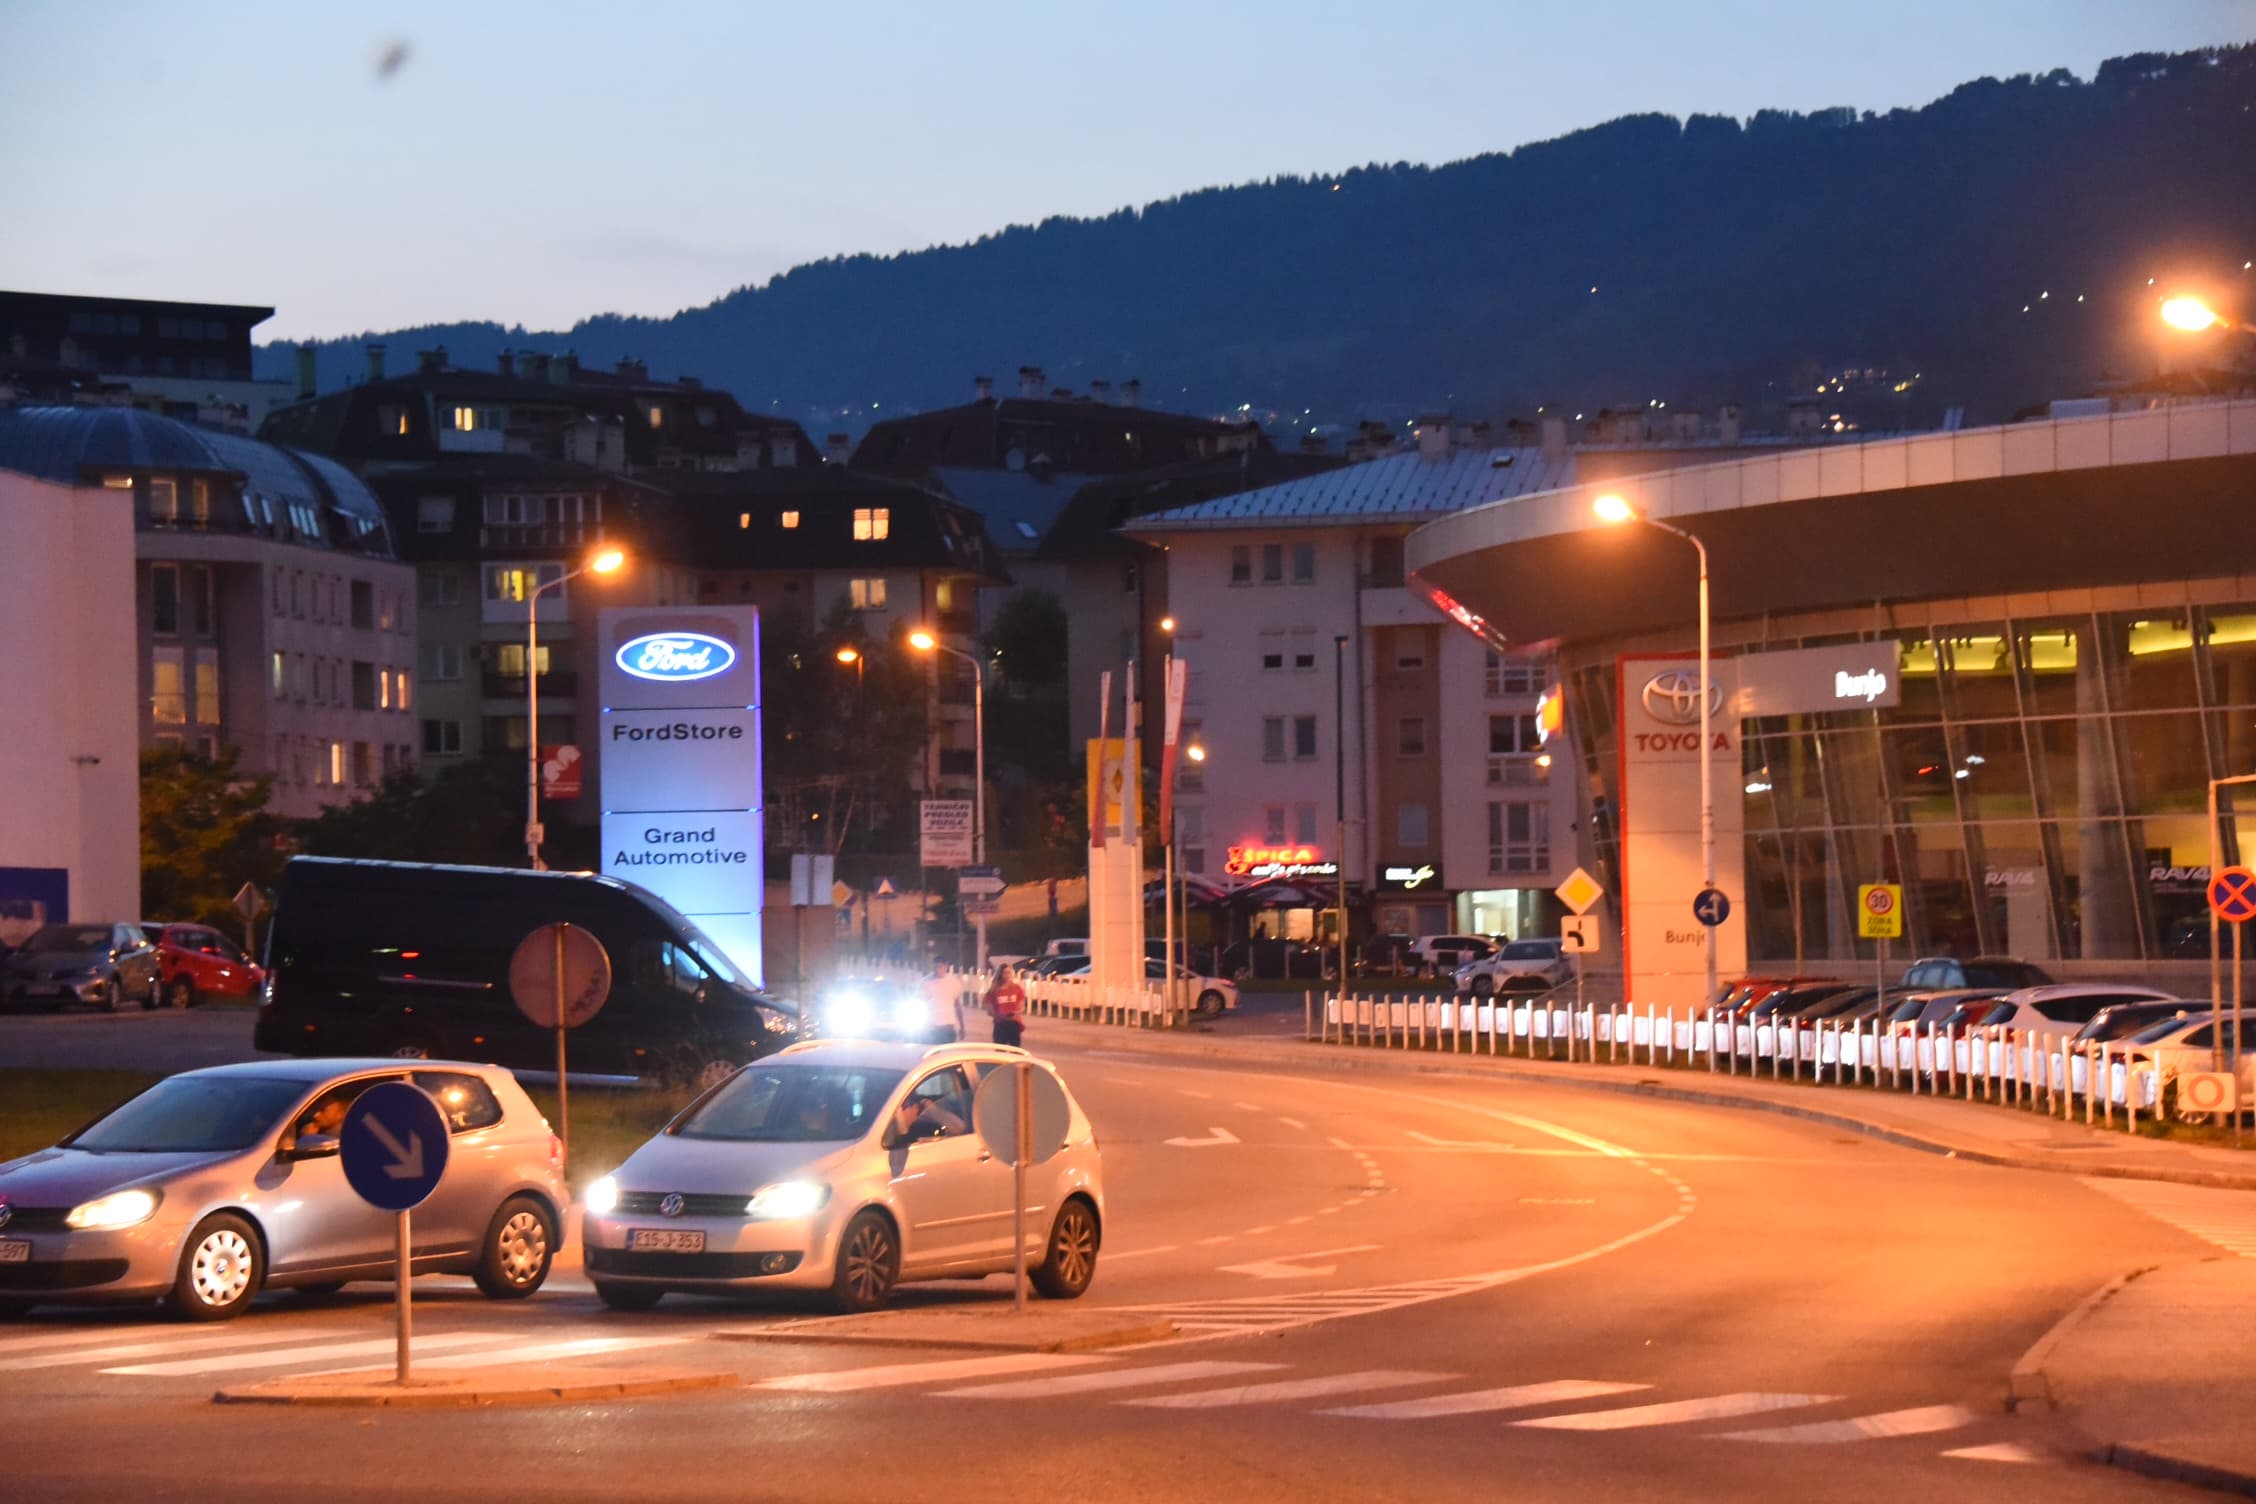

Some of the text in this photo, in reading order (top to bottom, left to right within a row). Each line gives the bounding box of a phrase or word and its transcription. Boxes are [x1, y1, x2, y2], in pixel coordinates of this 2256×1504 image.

[637, 639, 712, 673] Ford
[1835, 668, 1887, 702] Bunjo
[612, 722, 744, 742] FordStore
[1634, 732, 1731, 752] TOYOA
[644, 827, 716, 844] Grand
[614, 849, 747, 867] Automotive
[1984, 871, 2035, 886] RAV4
[2149, 867, 2211, 881] RAV4
[1871, 894, 1889, 909] 30
